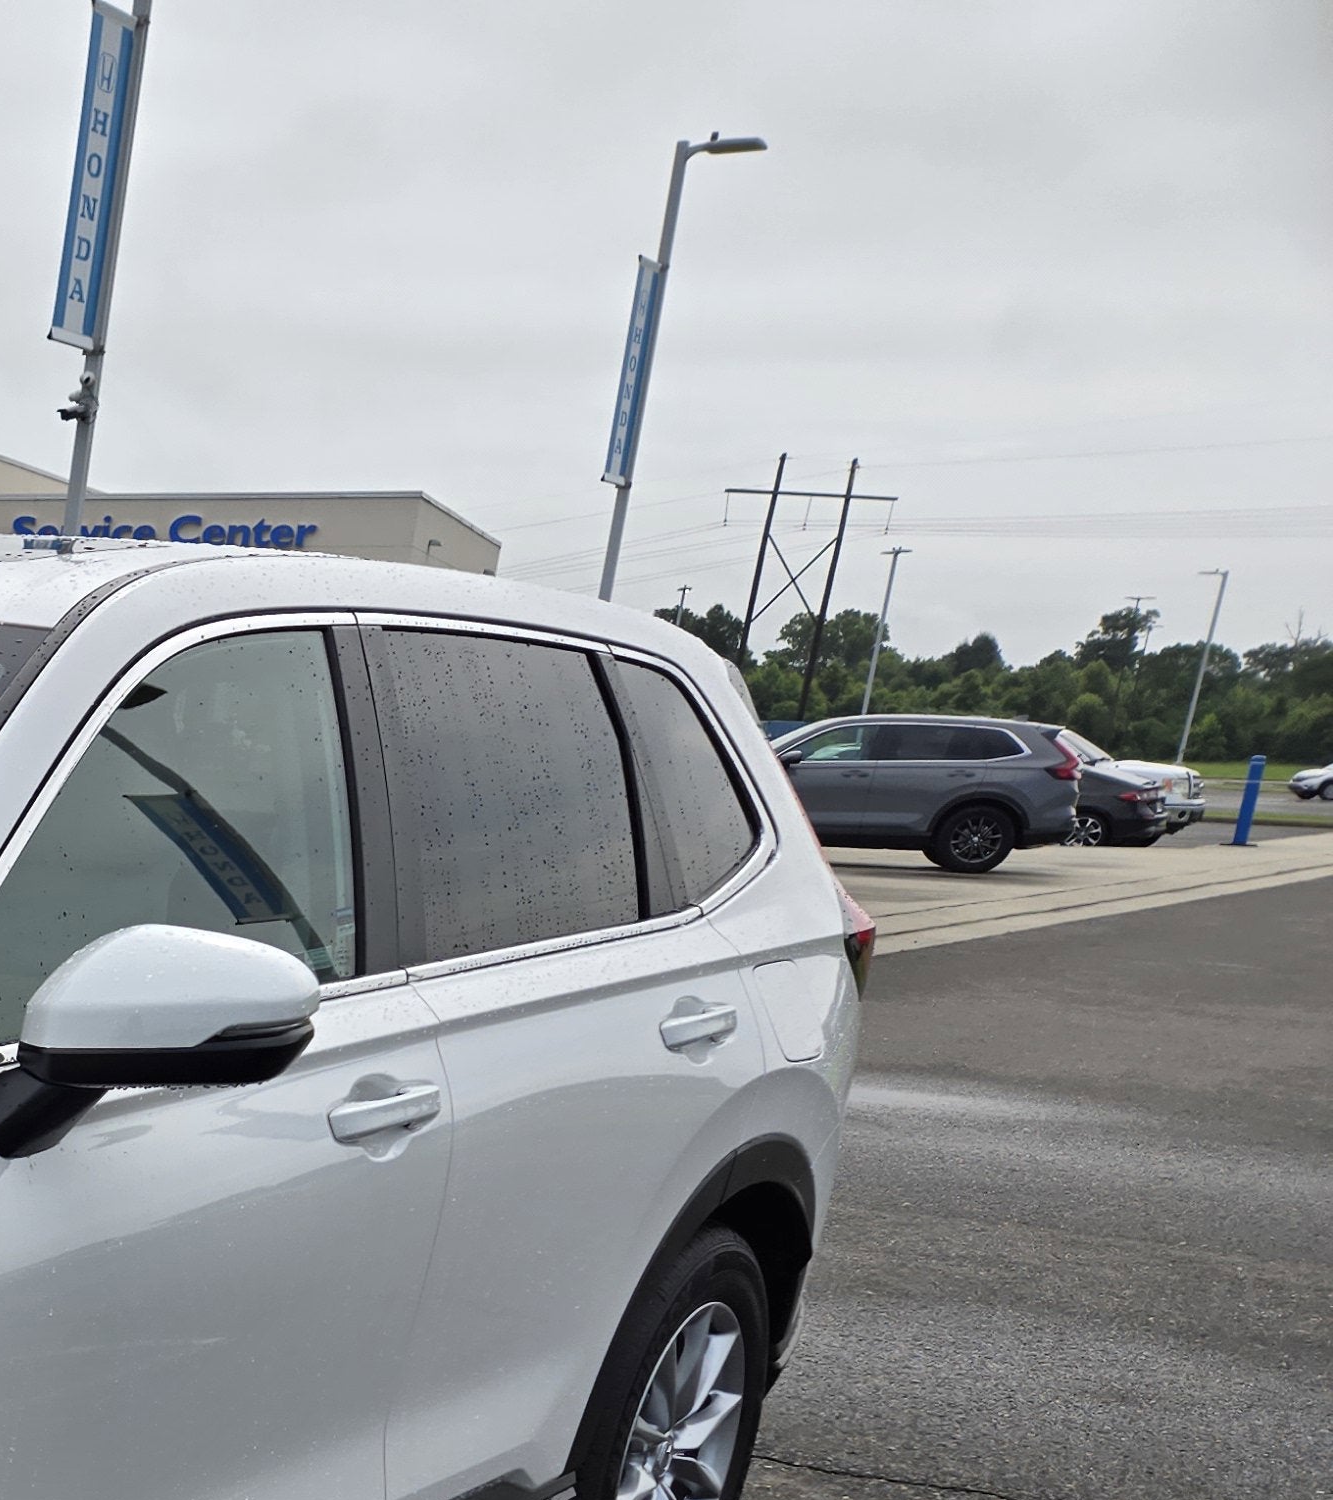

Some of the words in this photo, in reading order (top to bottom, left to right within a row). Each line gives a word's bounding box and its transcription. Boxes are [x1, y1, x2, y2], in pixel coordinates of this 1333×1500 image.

[68, 108, 110, 305] HONDA
[613, 327, 642, 454] HONDA
[12, 516, 157, 541] Sevice
[168, 514, 318, 549] Center
